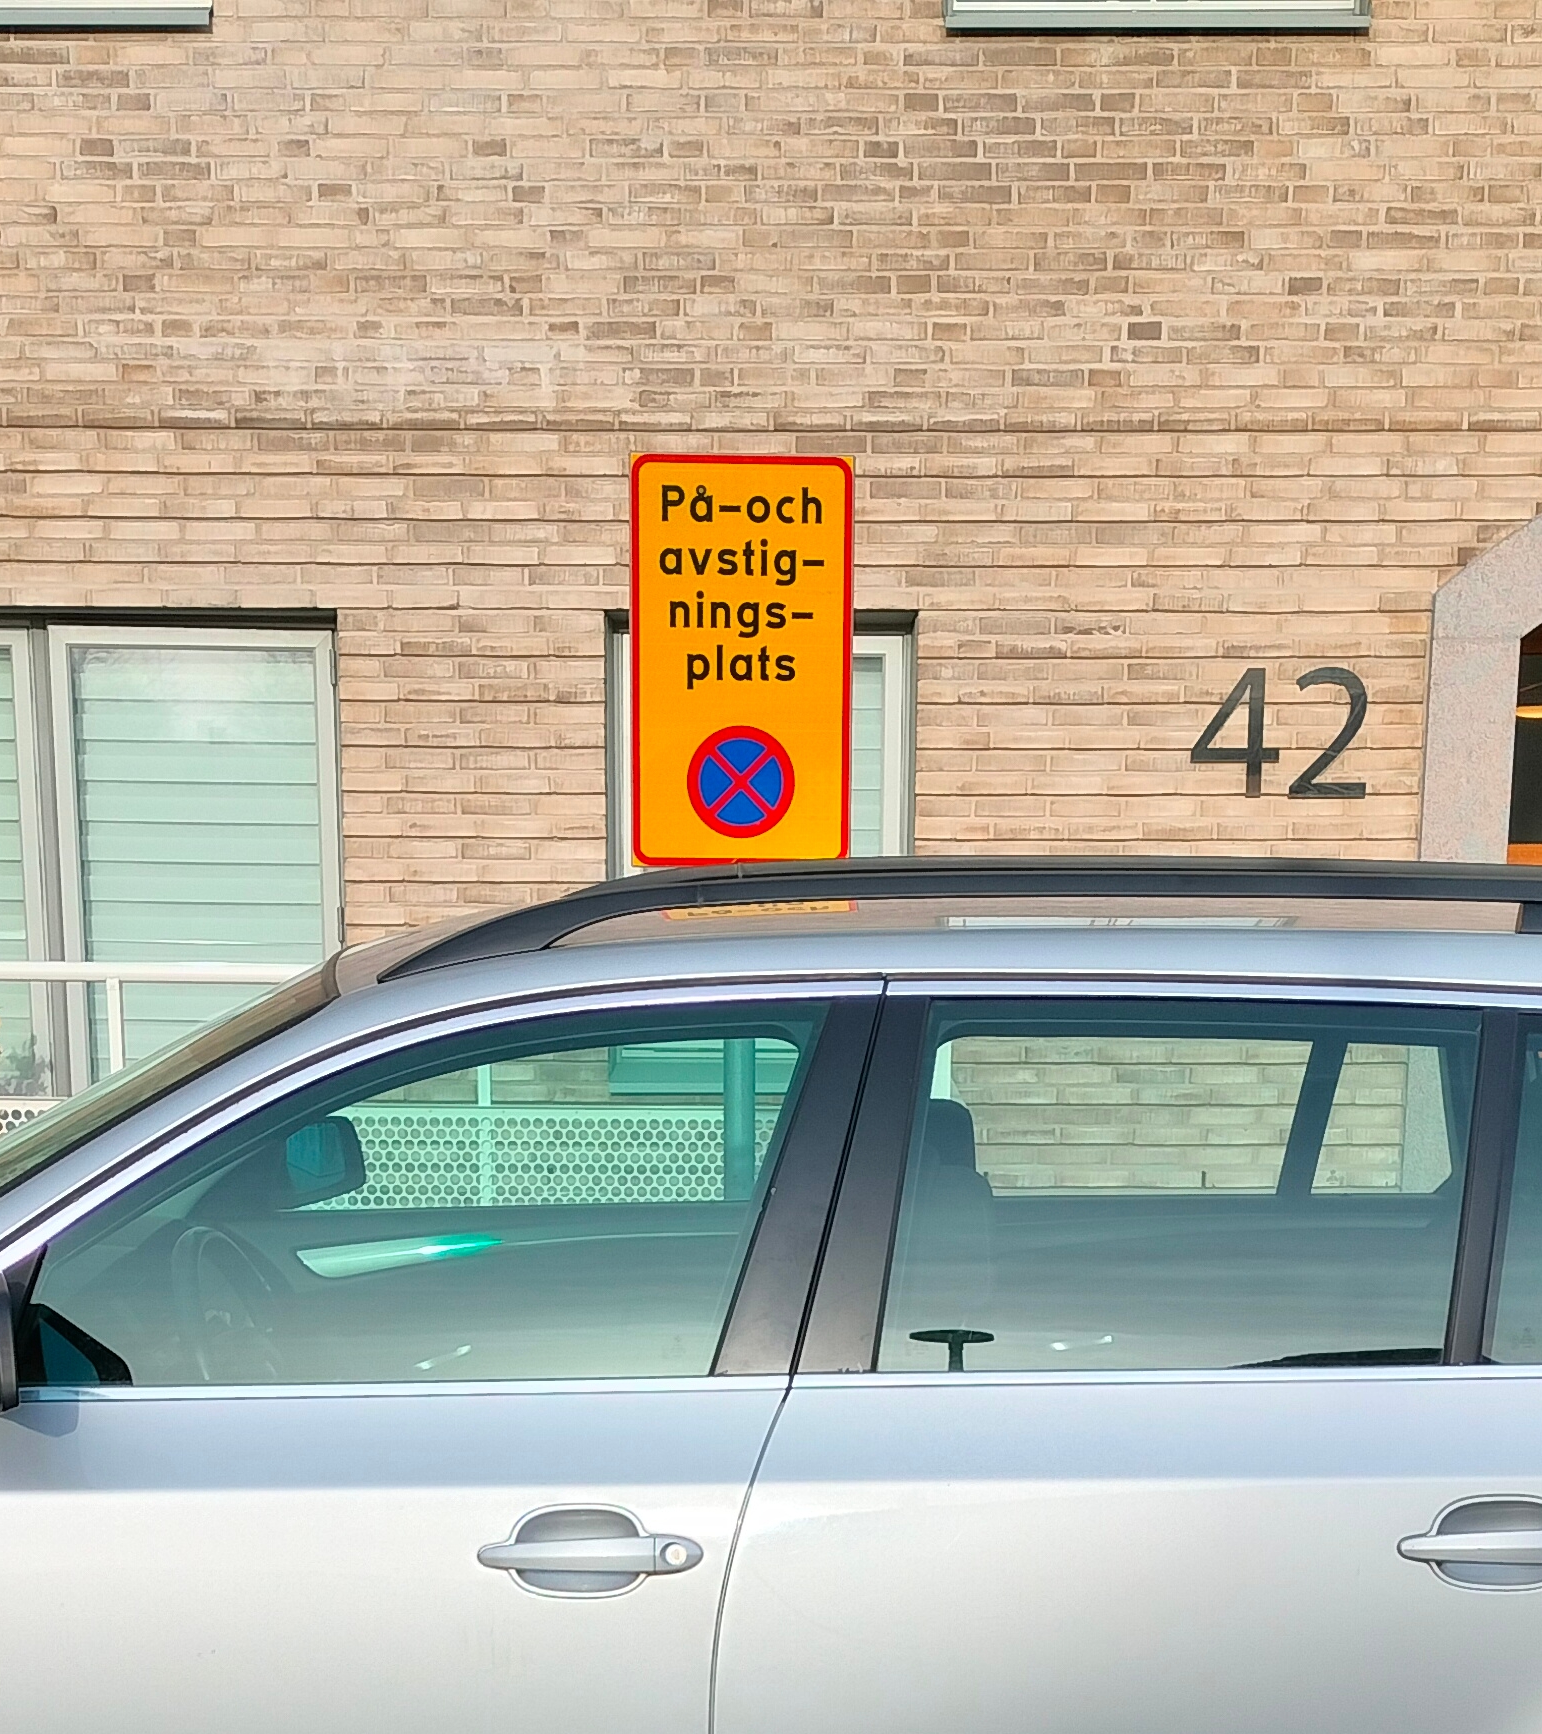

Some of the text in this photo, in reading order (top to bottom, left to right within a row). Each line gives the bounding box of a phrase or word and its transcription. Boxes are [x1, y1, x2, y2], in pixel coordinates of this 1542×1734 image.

[660, 539, 824, 585] avstig-
[670, 591, 813, 638] nings-
[687, 645, 795, 689] plats
[1190, 667, 1368, 799] 42
